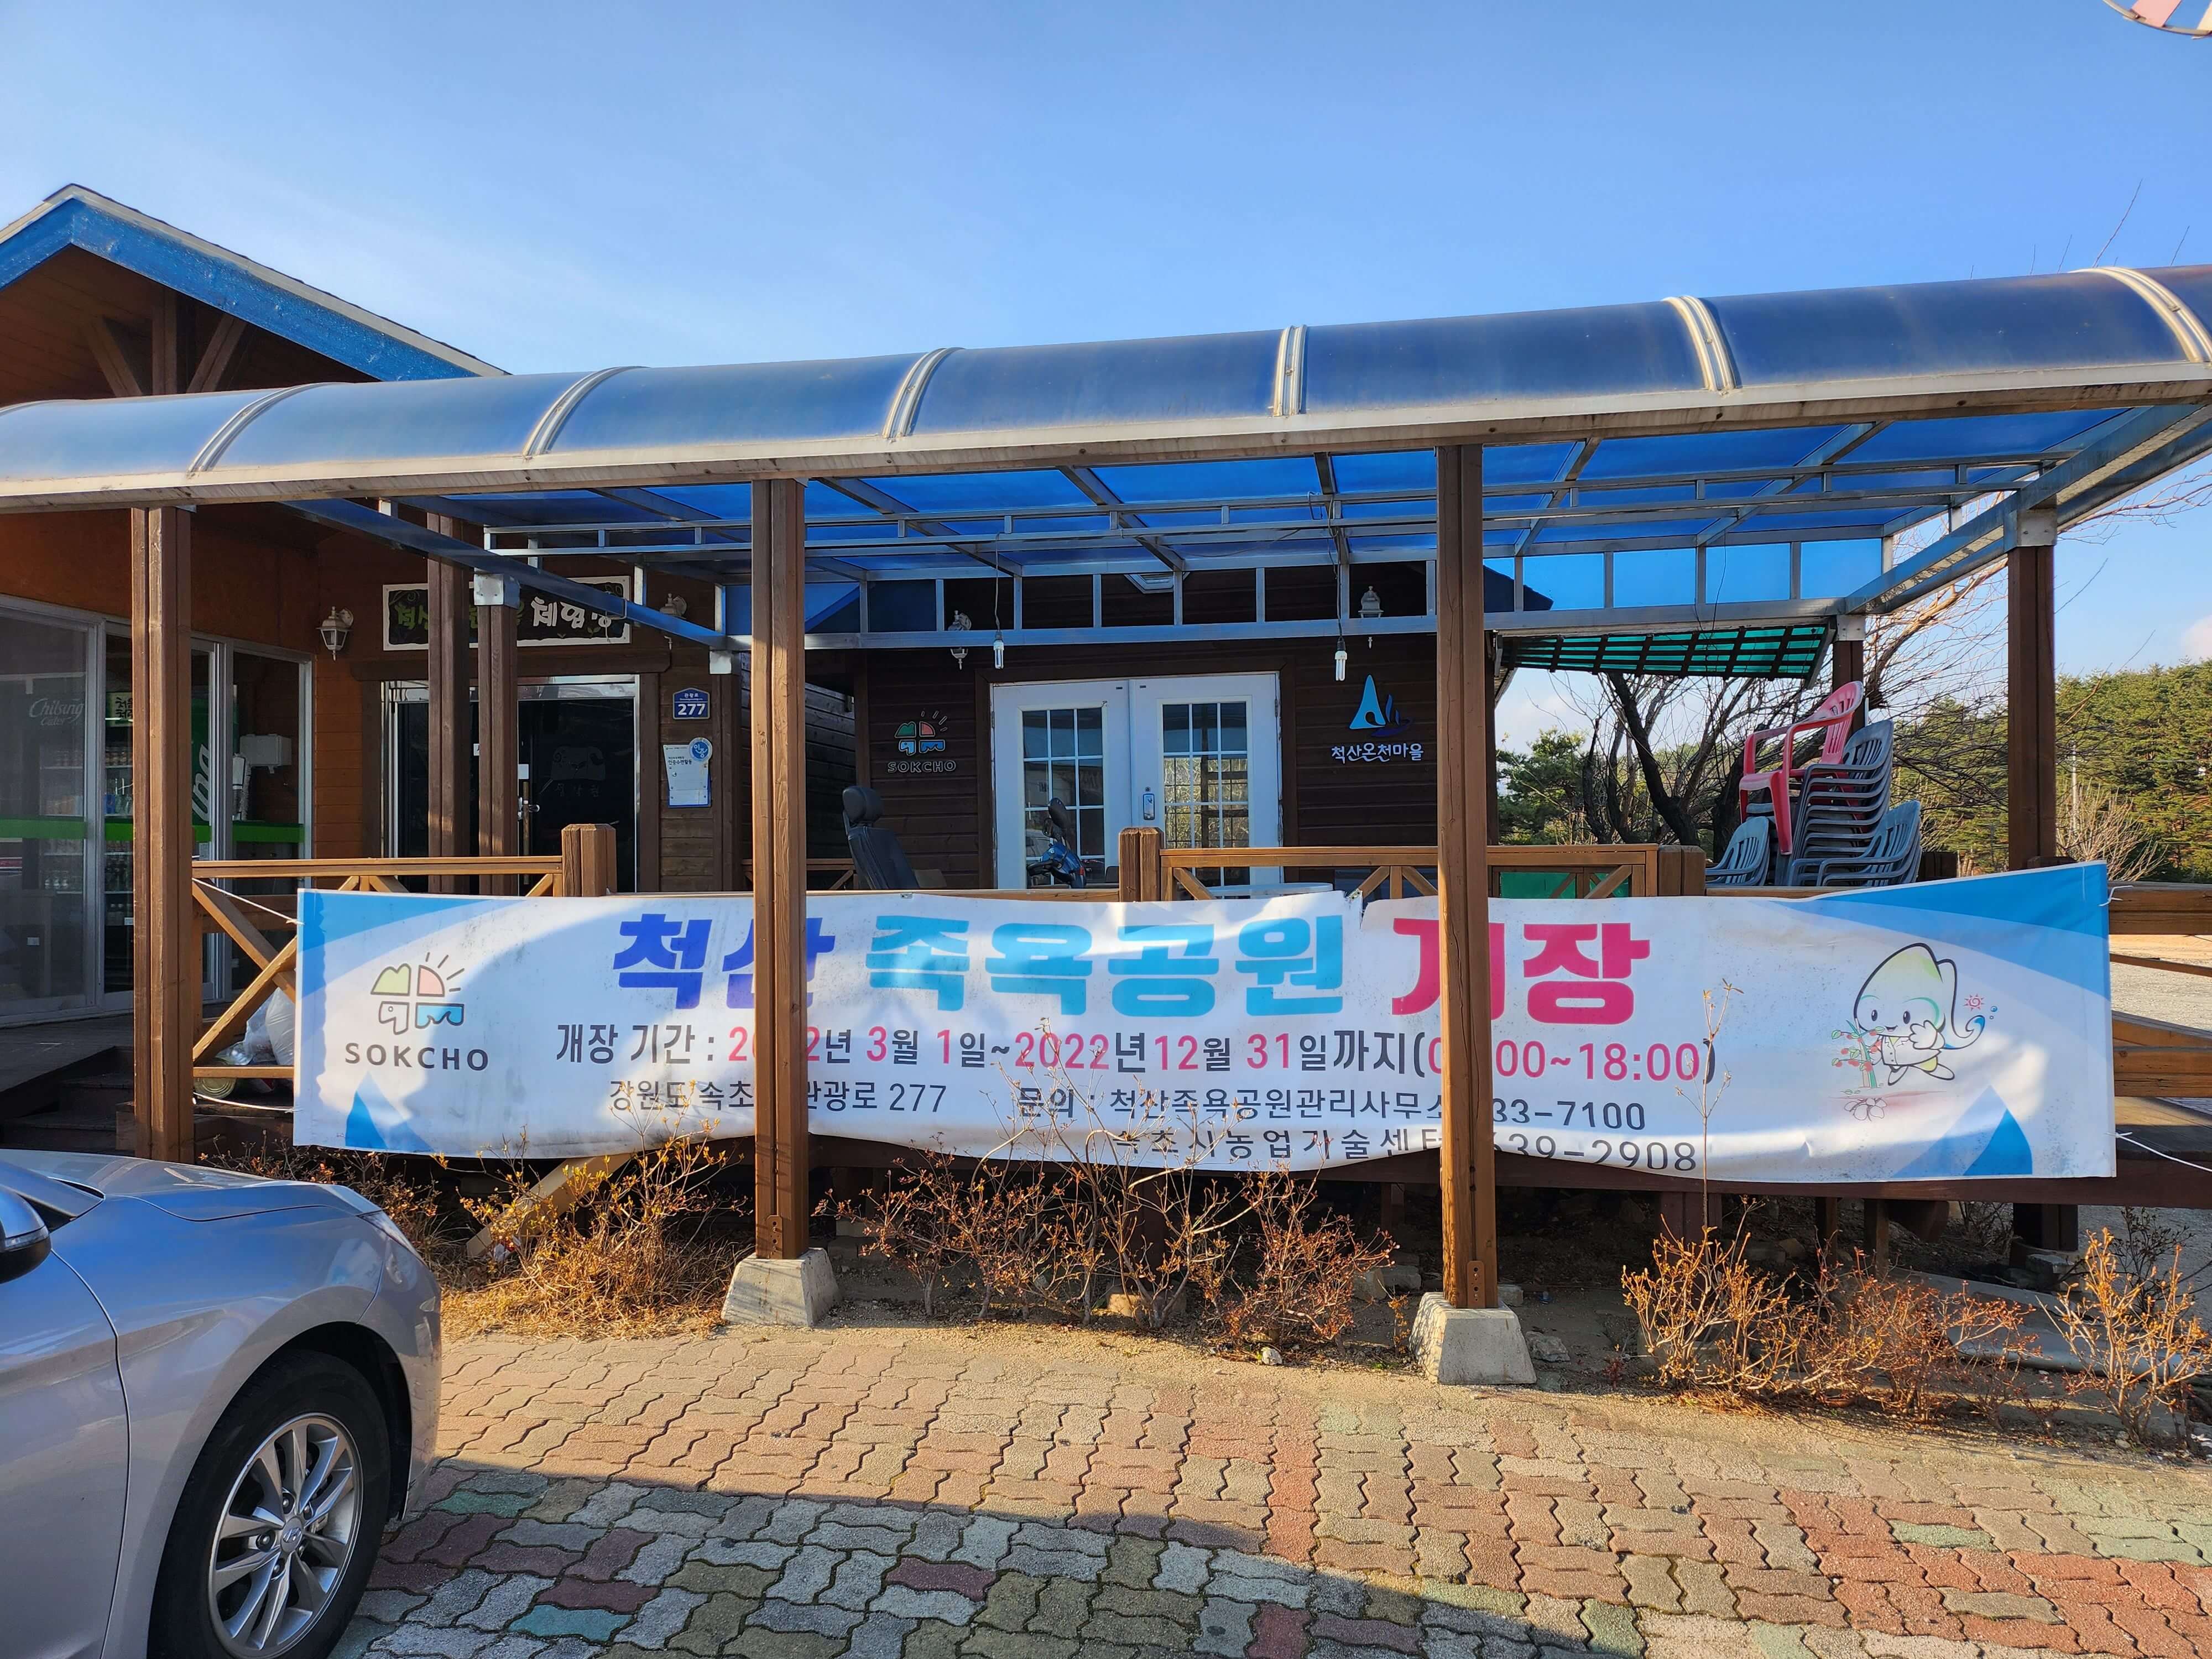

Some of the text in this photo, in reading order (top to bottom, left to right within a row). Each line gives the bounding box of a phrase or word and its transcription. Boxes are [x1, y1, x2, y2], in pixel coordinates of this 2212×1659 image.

[678, 703, 706, 715] 277
[888, 760, 956, 773] SOKCHO
[1332, 743, 1424, 764] 척산온천마을
[865, 915, 1343, 1017] 족욕공원
[345, 1042, 488, 1071] SOKCHO
[556, 1024, 618, 1064] 개장
[630, 1024, 695, 1064] 기간
[728, 1026, 851, 1064] 22년
[867, 1026, 918, 1065] 3월
[611, 1081, 686, 1111] 강원도
[699, 1081, 755, 1111] 속초
[889, 1083, 946, 1112] 277
[1493, 1098, 1646, 1130] 33-7100
